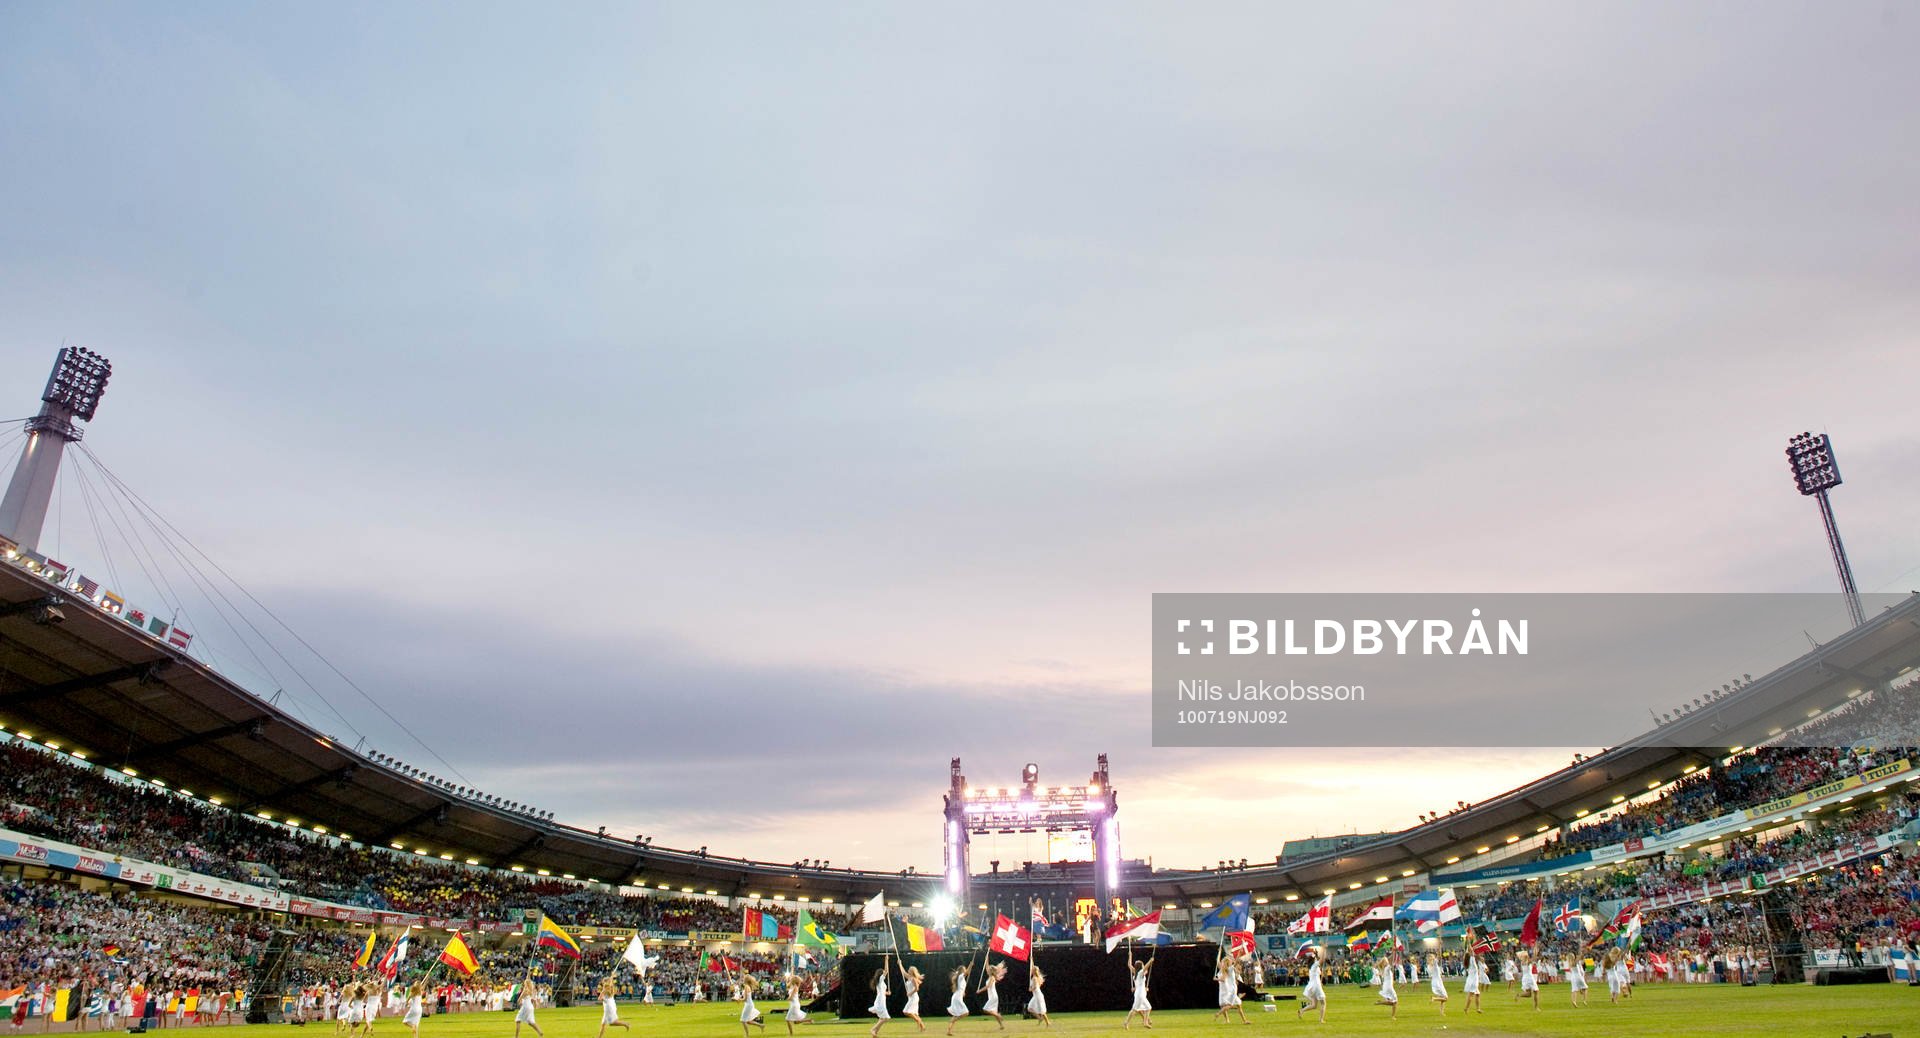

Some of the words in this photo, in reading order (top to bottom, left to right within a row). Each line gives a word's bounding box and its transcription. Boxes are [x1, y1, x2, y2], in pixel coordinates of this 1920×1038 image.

[1867, 763, 1901, 780] TULIP
[1813, 782, 1844, 797] TULIP
[1761, 799, 1792, 814] TULIP
[604, 928, 631, 936] TULIP
